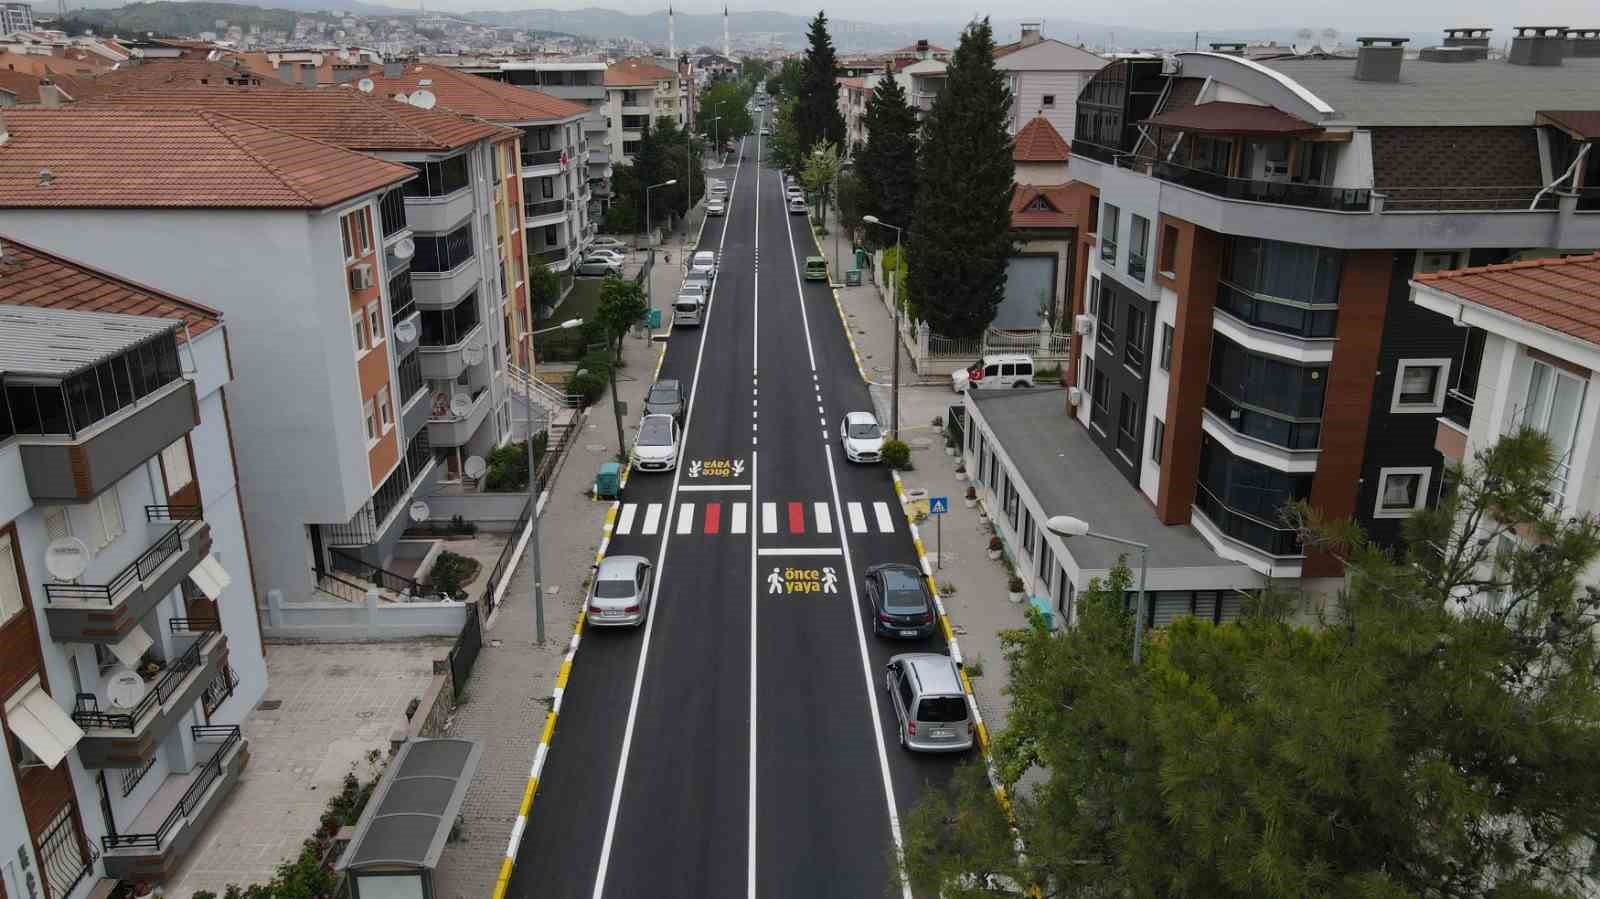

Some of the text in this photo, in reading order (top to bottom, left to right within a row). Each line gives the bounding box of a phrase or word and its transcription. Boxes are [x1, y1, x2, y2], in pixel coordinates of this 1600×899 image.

[704, 459, 731, 468] yaya
[785, 568, 819, 581] önce
[785, 580, 821, 594] yaya
